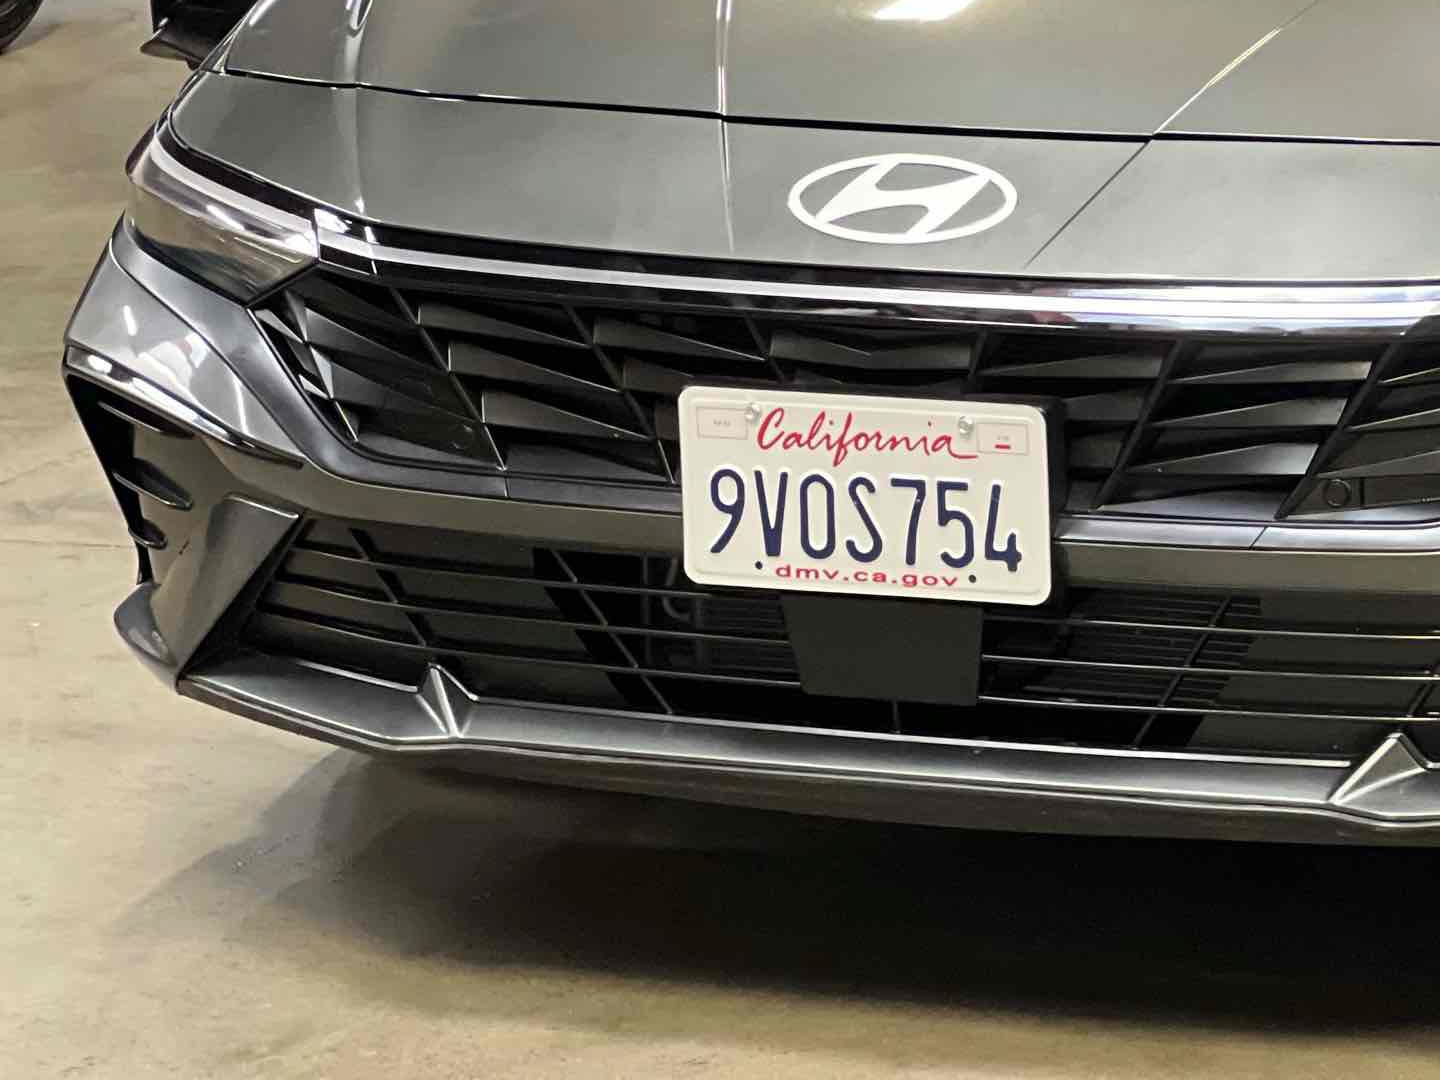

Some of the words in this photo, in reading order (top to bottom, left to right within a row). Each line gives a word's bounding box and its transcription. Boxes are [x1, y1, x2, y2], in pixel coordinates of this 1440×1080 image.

[756, 407, 978, 467] California
[709, 468, 1023, 573] 9VOS754
[775, 563, 959, 589] dmv.ca.gov
